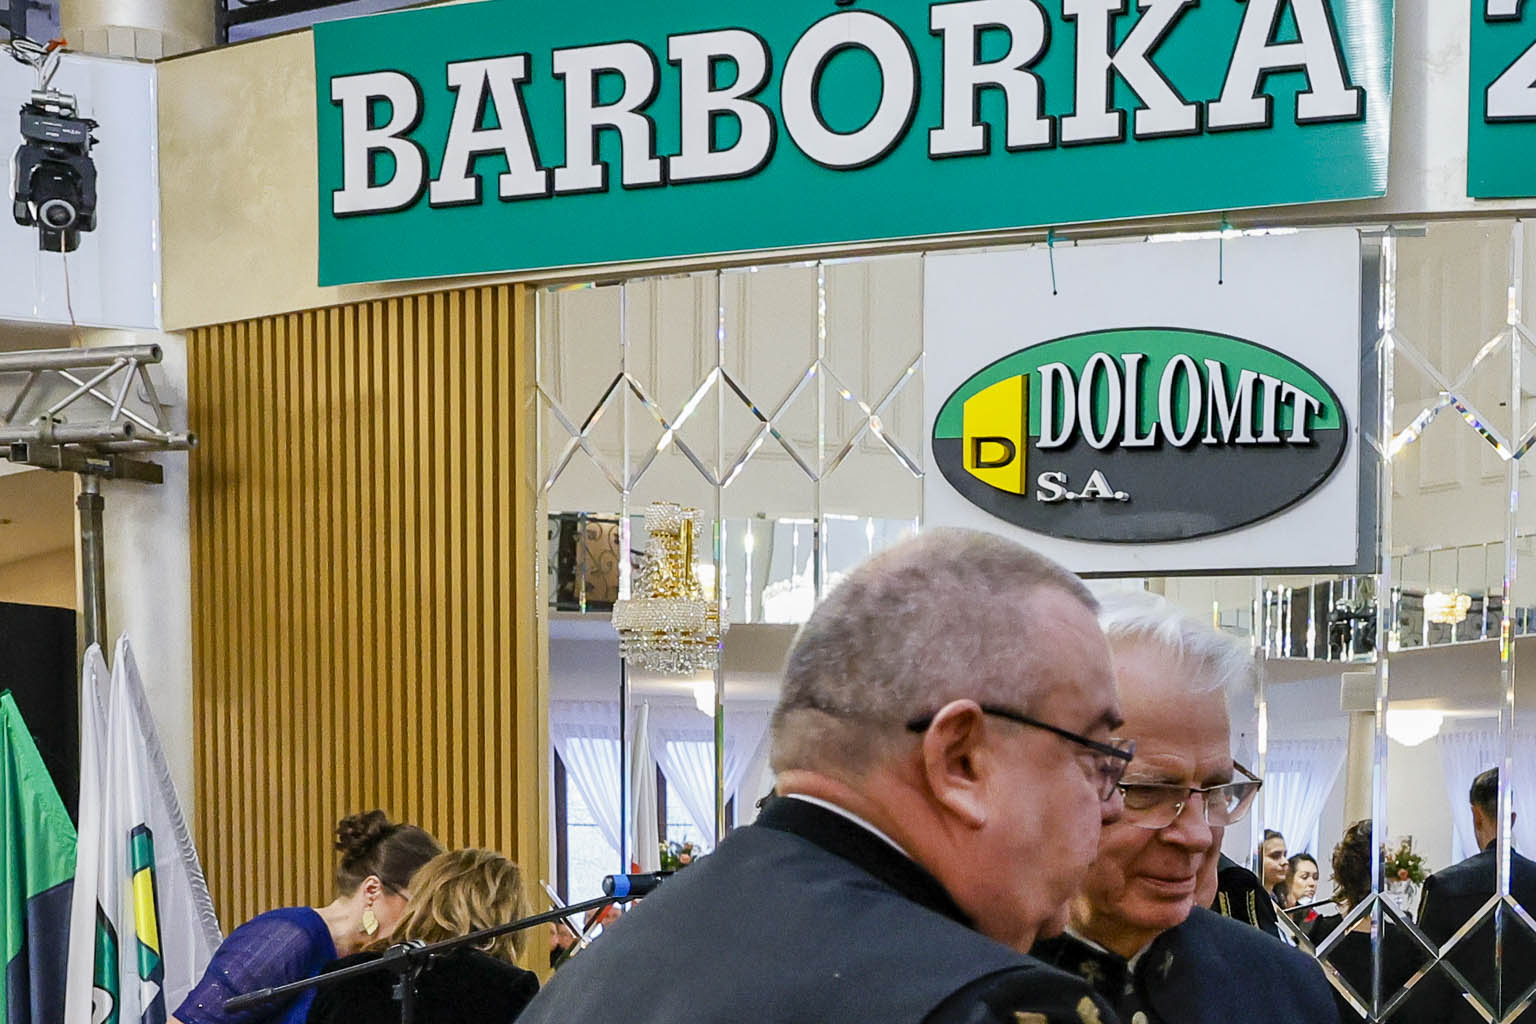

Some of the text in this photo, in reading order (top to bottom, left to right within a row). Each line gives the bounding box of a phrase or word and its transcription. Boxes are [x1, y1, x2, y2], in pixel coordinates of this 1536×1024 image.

[1036, 352, 1322, 450] DOLOMIT
[970, 437, 1016, 469] D
[1036, 469, 1130, 503] S.A.
